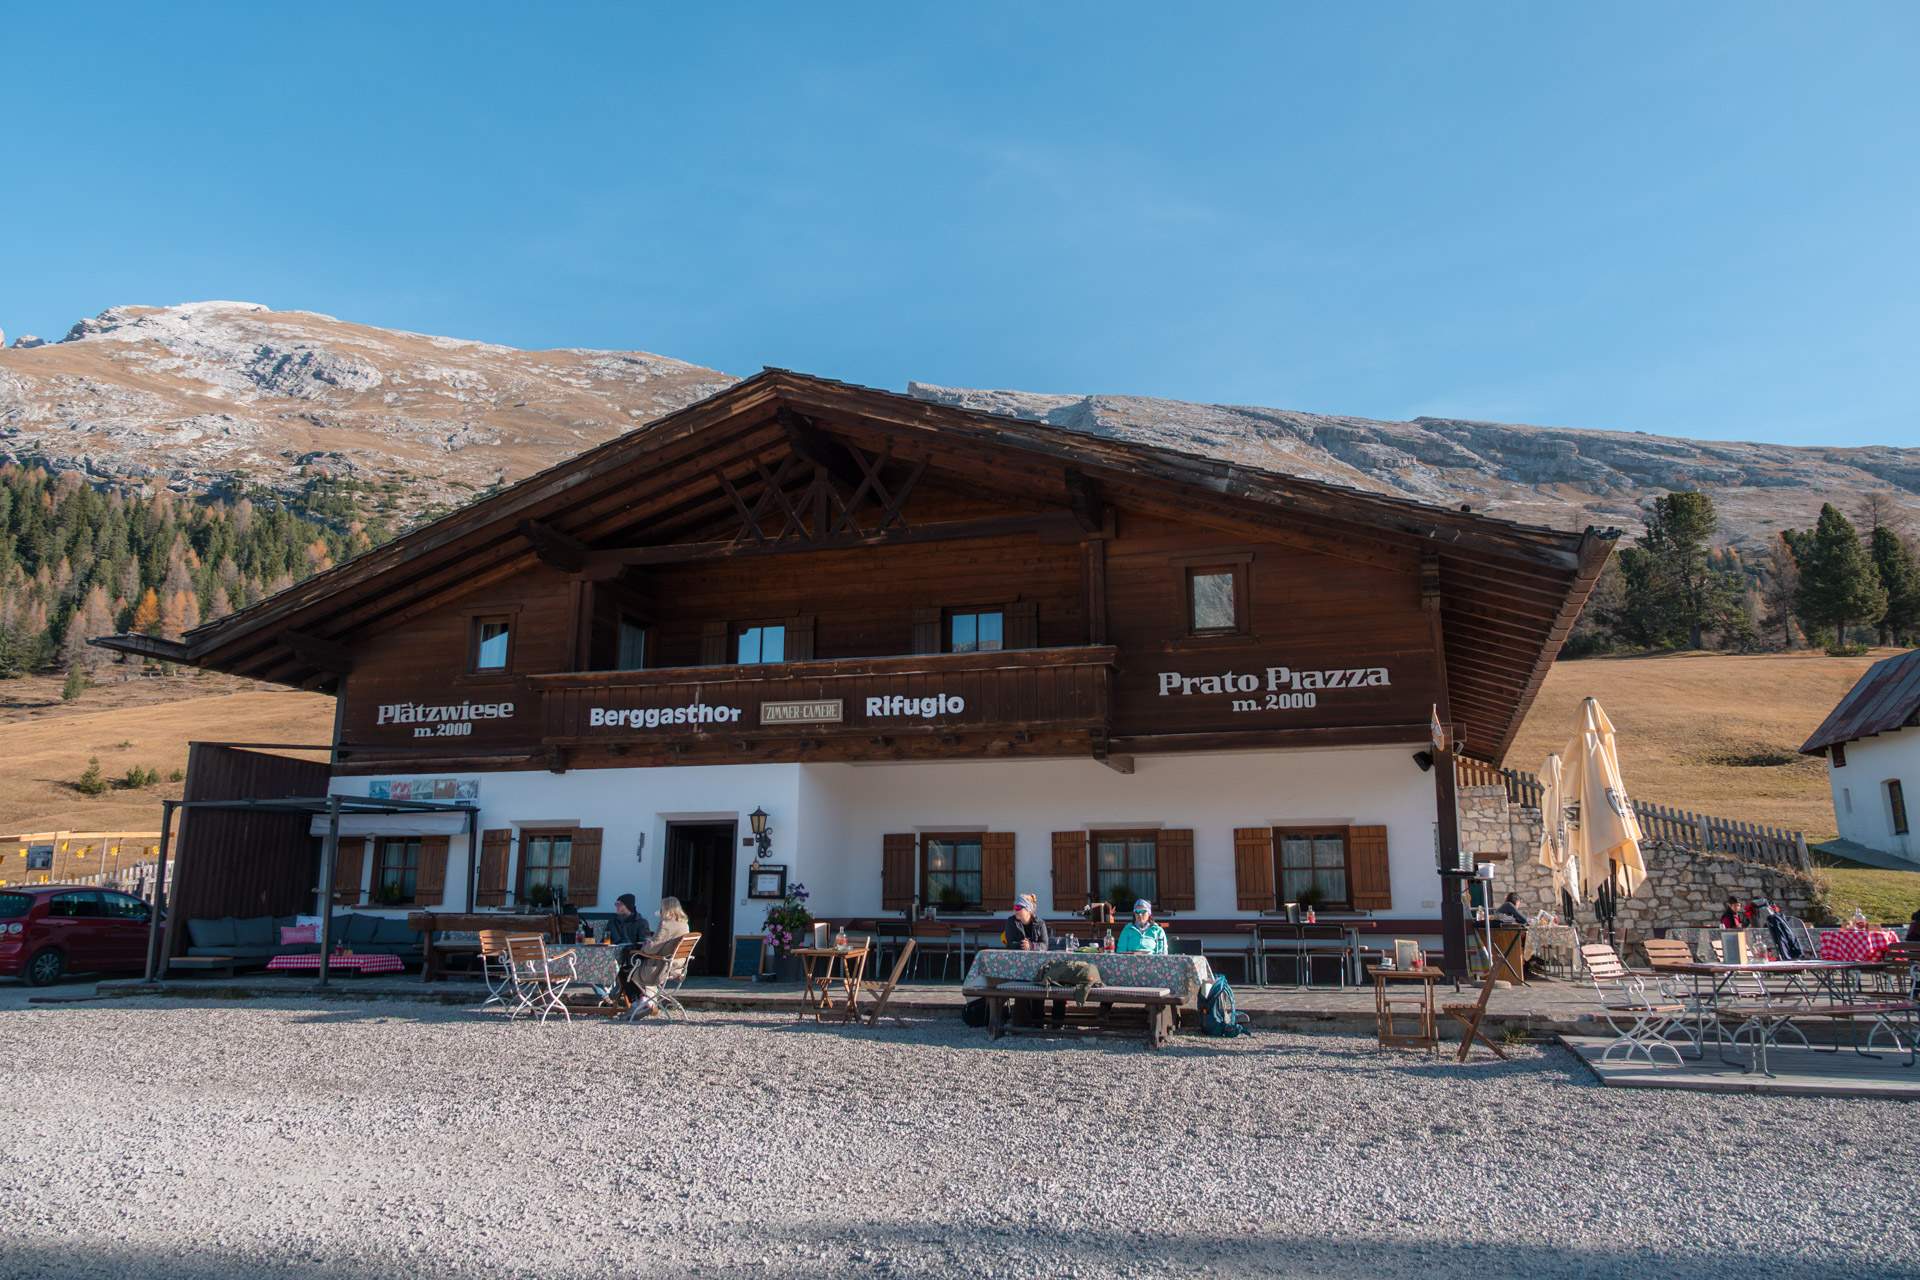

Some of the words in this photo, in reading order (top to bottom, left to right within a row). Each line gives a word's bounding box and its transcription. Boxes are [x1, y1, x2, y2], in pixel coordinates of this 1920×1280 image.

[1158, 669, 1259, 696] Prato
[1266, 666, 1391, 692] Piazza
[766, 704, 838, 720] ZIMMER-CAMERE
[866, 693, 965, 718] Rifugio
